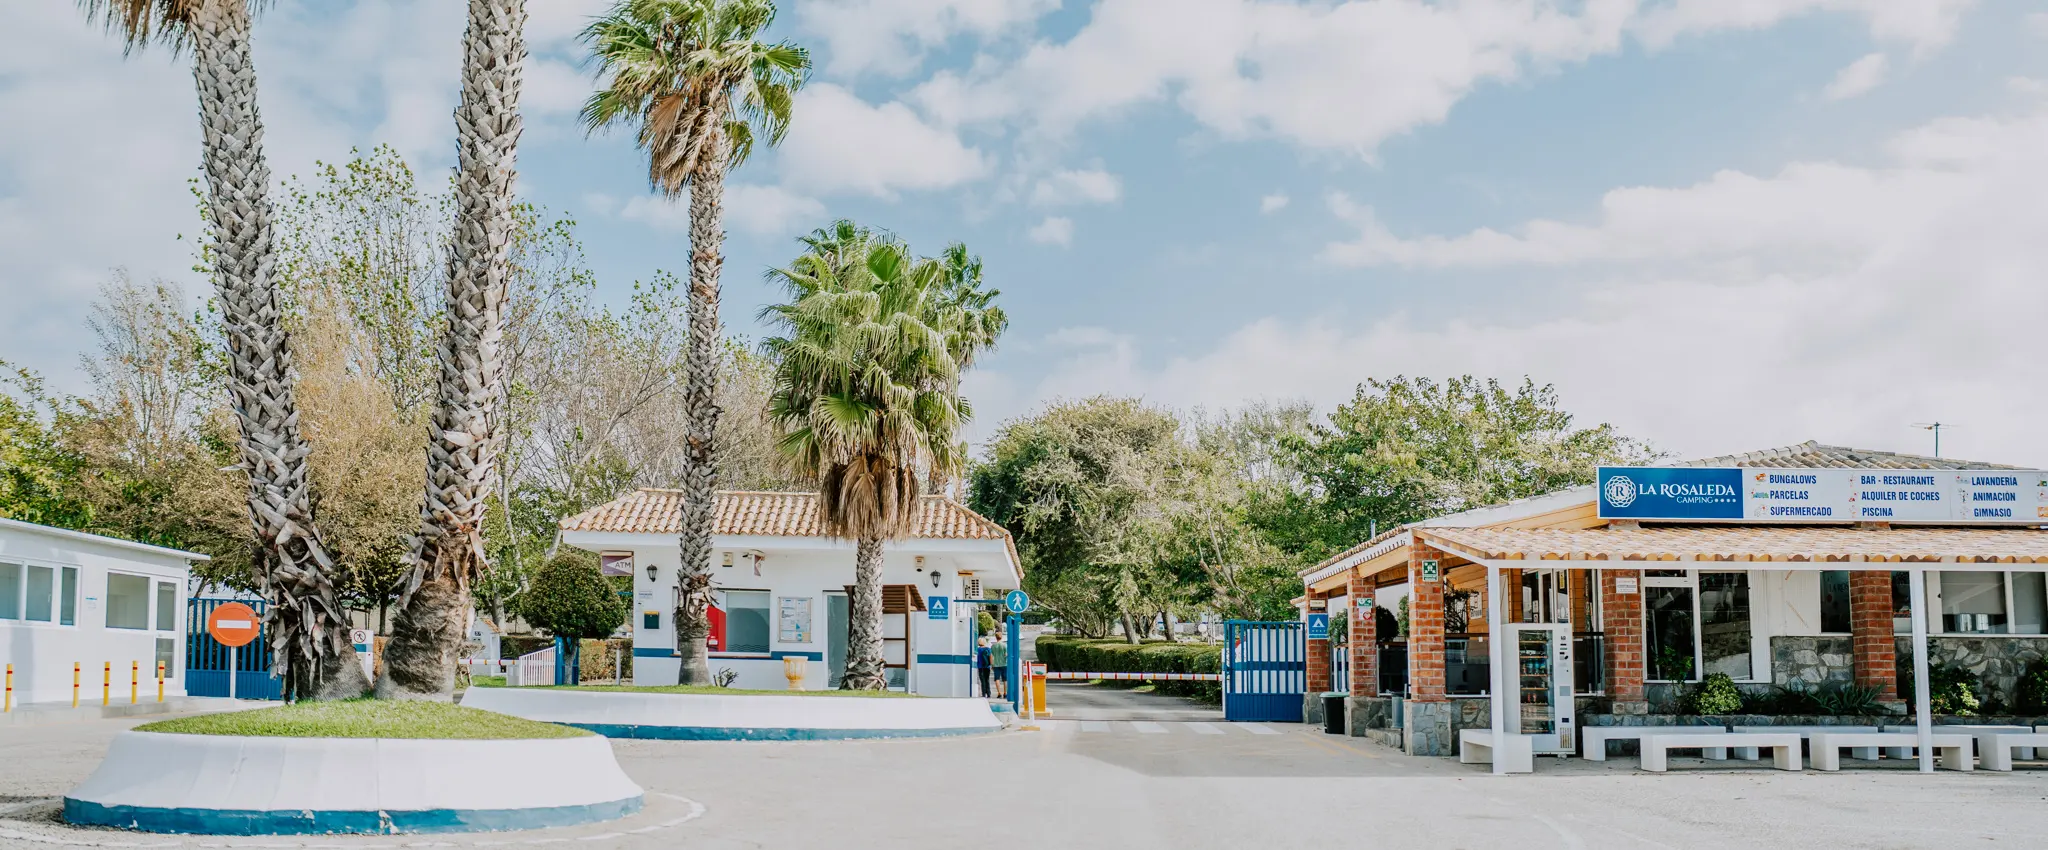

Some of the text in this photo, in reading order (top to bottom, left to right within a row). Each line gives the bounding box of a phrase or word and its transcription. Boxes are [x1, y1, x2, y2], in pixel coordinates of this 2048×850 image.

[1769, 474, 1817, 484] BUNGALOWS
[1860, 475, 1876, 485] BAR
[1883, 475, 1935, 486] RESTAURANTE
[1639, 484, 1735, 498] LA ROSALEDA
[1770, 490, 1809, 500] PARCELAS
[1861, 491, 1940, 501] ALQUILER DE COCHES
[1676, 496, 1713, 504] CAMPING
[1770, 506, 1832, 516] SUPERMERCADO
[1862, 507, 1893, 517] PISCINA
[1974, 508, 2012, 517] GIMNASIO
